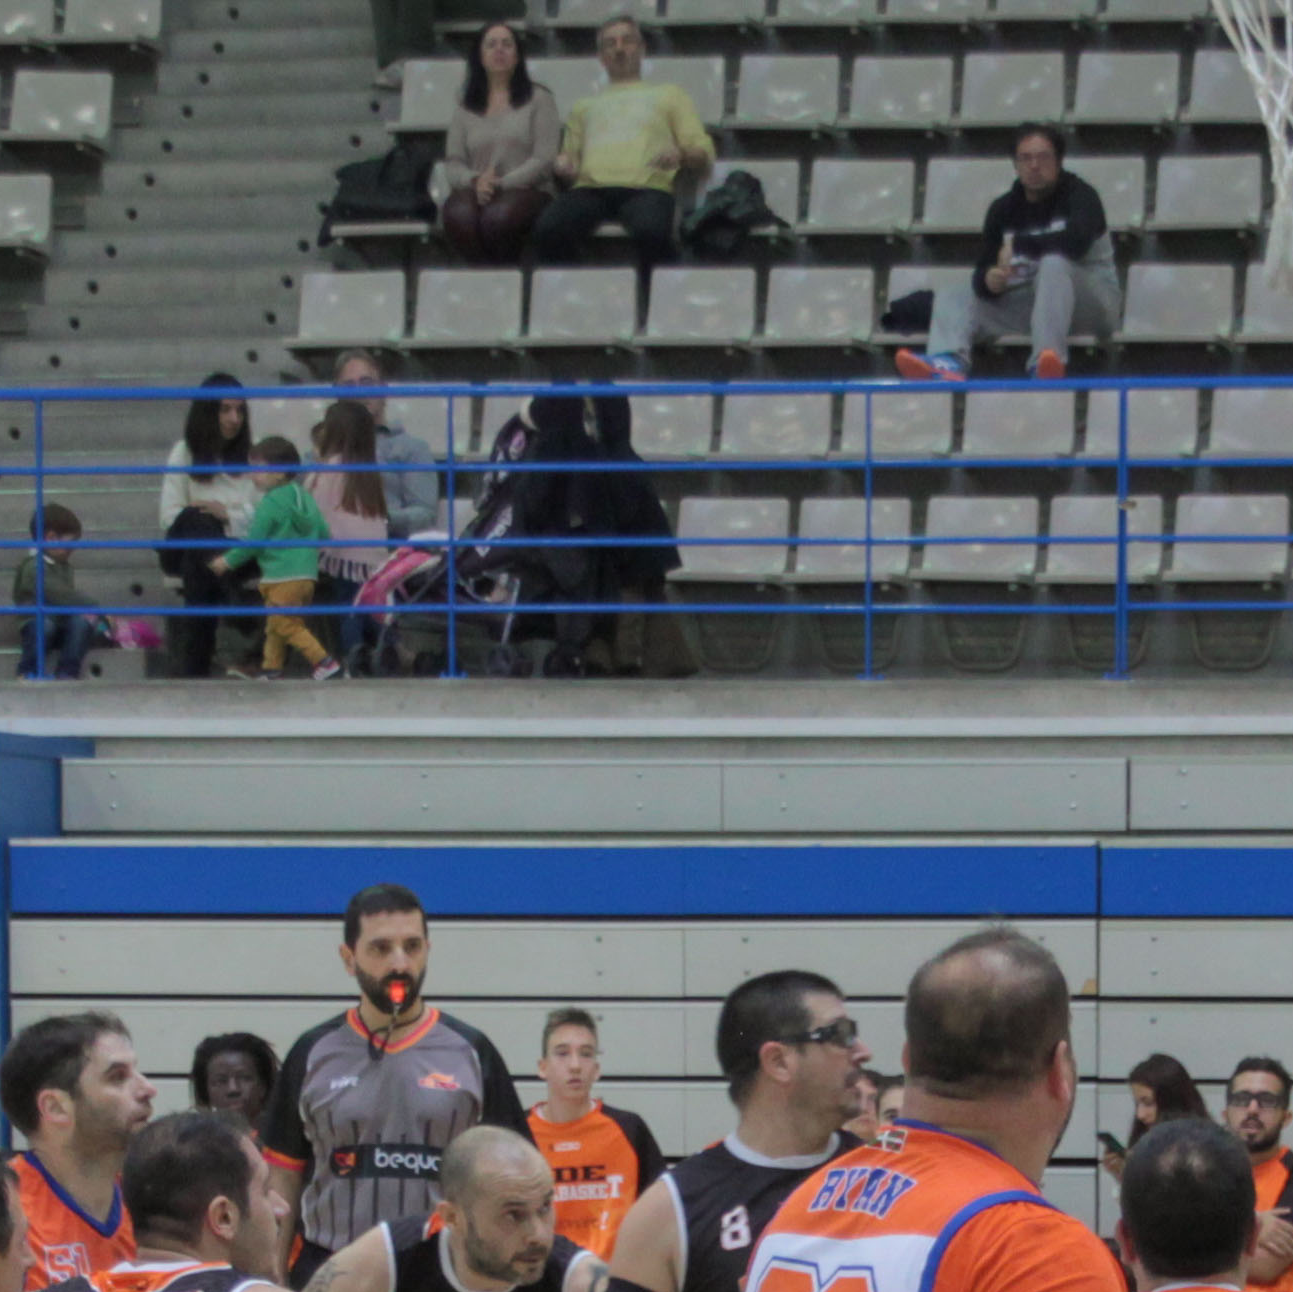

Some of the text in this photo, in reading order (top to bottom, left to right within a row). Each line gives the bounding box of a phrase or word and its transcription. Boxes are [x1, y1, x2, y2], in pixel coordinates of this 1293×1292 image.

[552, 1164, 606, 1182] DE
[808, 1167, 917, 1220] RYAN
[720, 1204, 752, 1251] 8
